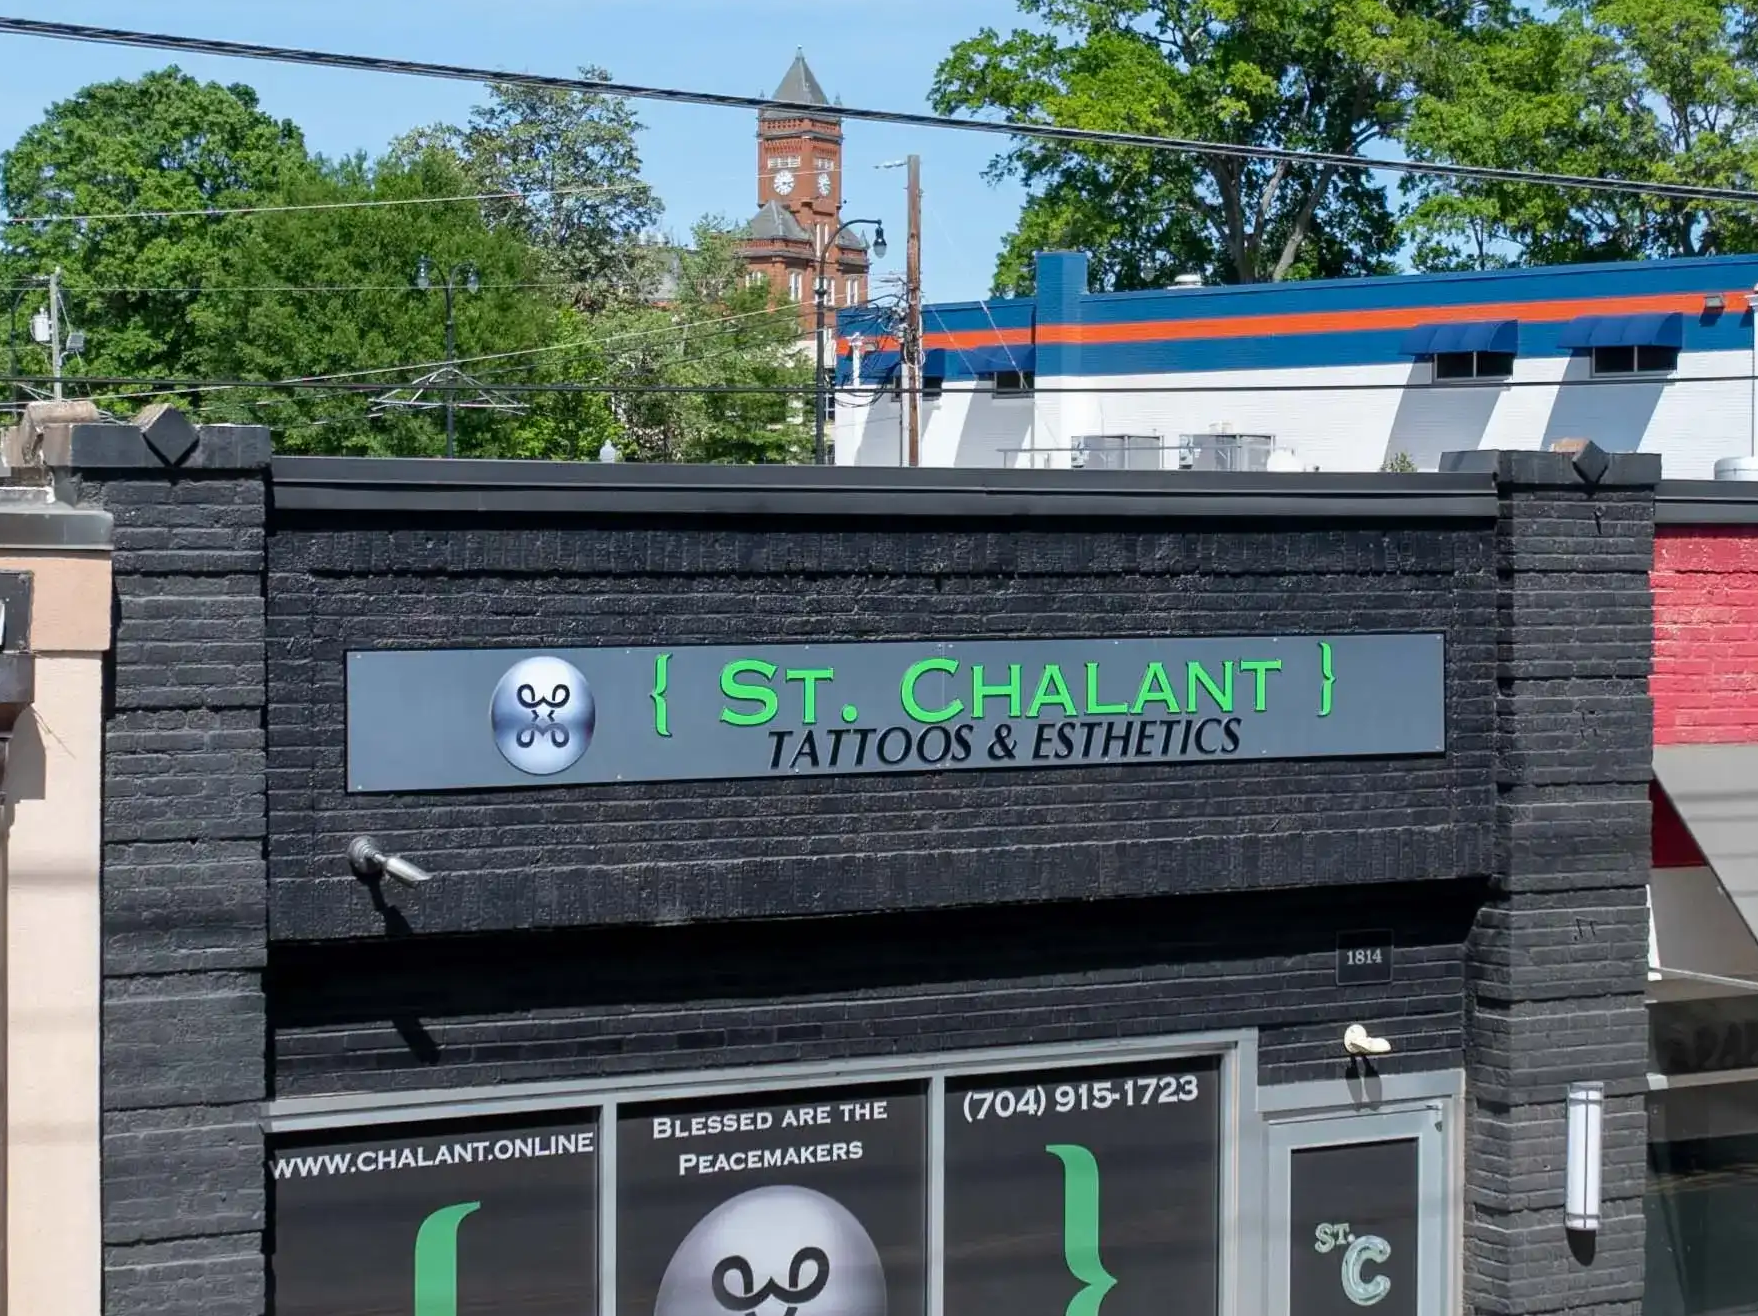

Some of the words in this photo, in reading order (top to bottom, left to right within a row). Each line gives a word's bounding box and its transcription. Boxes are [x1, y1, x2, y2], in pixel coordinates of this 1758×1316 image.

[899, 656, 1282, 724] CHALANT
[768, 724, 974, 770] TATTOOS
[987, 723, 1018, 761] &
[1031, 716, 1243, 761] ESTHETICS
[1346, 948, 1383, 965] 1814
[653, 1112, 773, 1139] BLESSED
[781, 1106, 831, 1128] ARE
[839, 1101, 888, 1122] THE
[963, 1085, 1047, 1123] (704)
[1055, 1075, 1199, 1113] 915-1723
[269, 1132, 594, 1179] WWW.CHALANT.ONLINE
[679, 1141, 864, 1176] PEACEMAKERS
[1314, 1222, 1356, 1254] ST.
[1341, 1234, 1392, 1306] C
